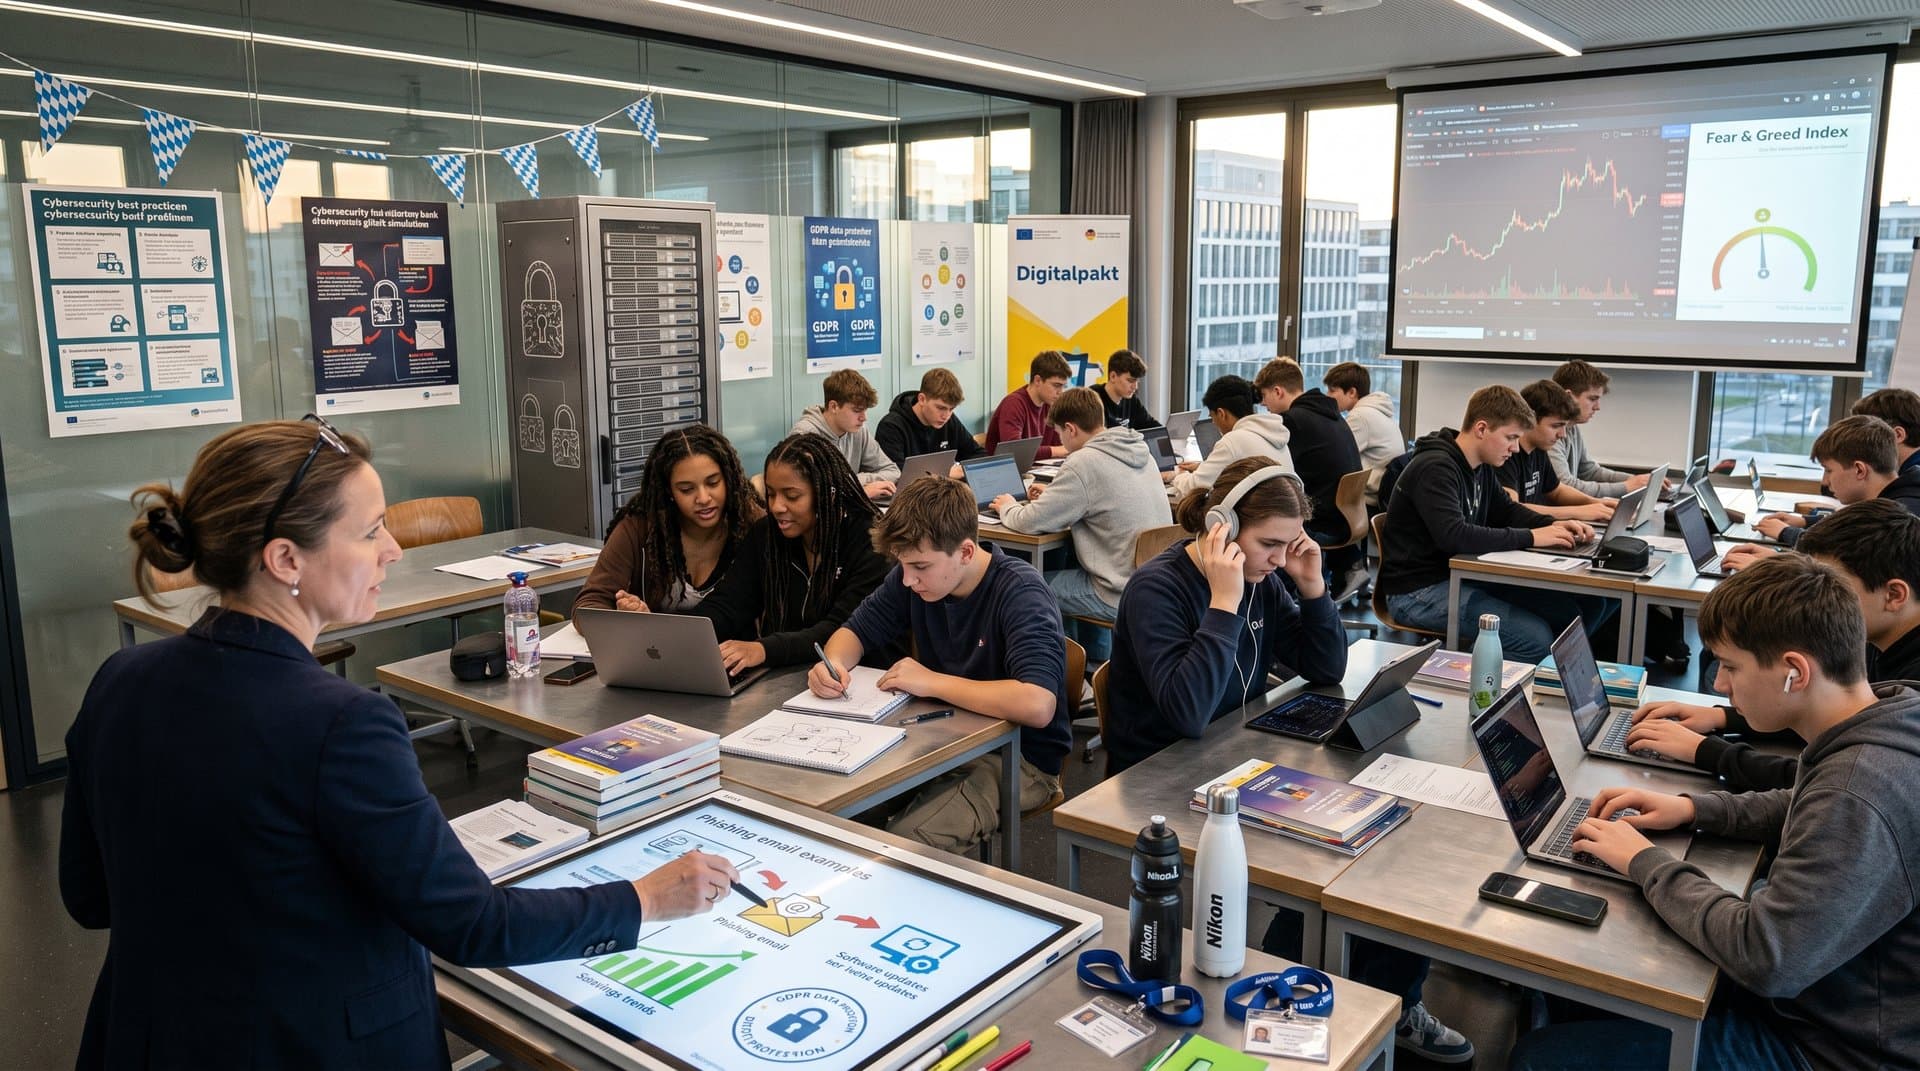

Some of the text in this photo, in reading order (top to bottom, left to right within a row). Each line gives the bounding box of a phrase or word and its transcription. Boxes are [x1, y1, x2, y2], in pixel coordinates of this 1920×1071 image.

[1706, 125, 1848, 144] Fear & Greed Index
[42, 197, 115, 210] Cybersecurity
[117, 200, 139, 209] best
[311, 206, 369, 218] Cybersecurity
[810, 225, 829, 234] GDPR
[1016, 265, 1120, 285] Digitalpakt
[812, 320, 839, 332] GDPR
[850, 319, 875, 331] GDPR
[697, 814, 873, 881] Phishing email examples
[1206, 893, 1223, 949] Nikon
[713, 916, 790, 951] Phishing email
[835, 951, 929, 993] Software updates
[874, 974, 918, 1001] updates
[622, 996, 656, 1015] trends
[776, 991, 811, 1003] GDPR
[813, 992, 839, 1005] DATA
